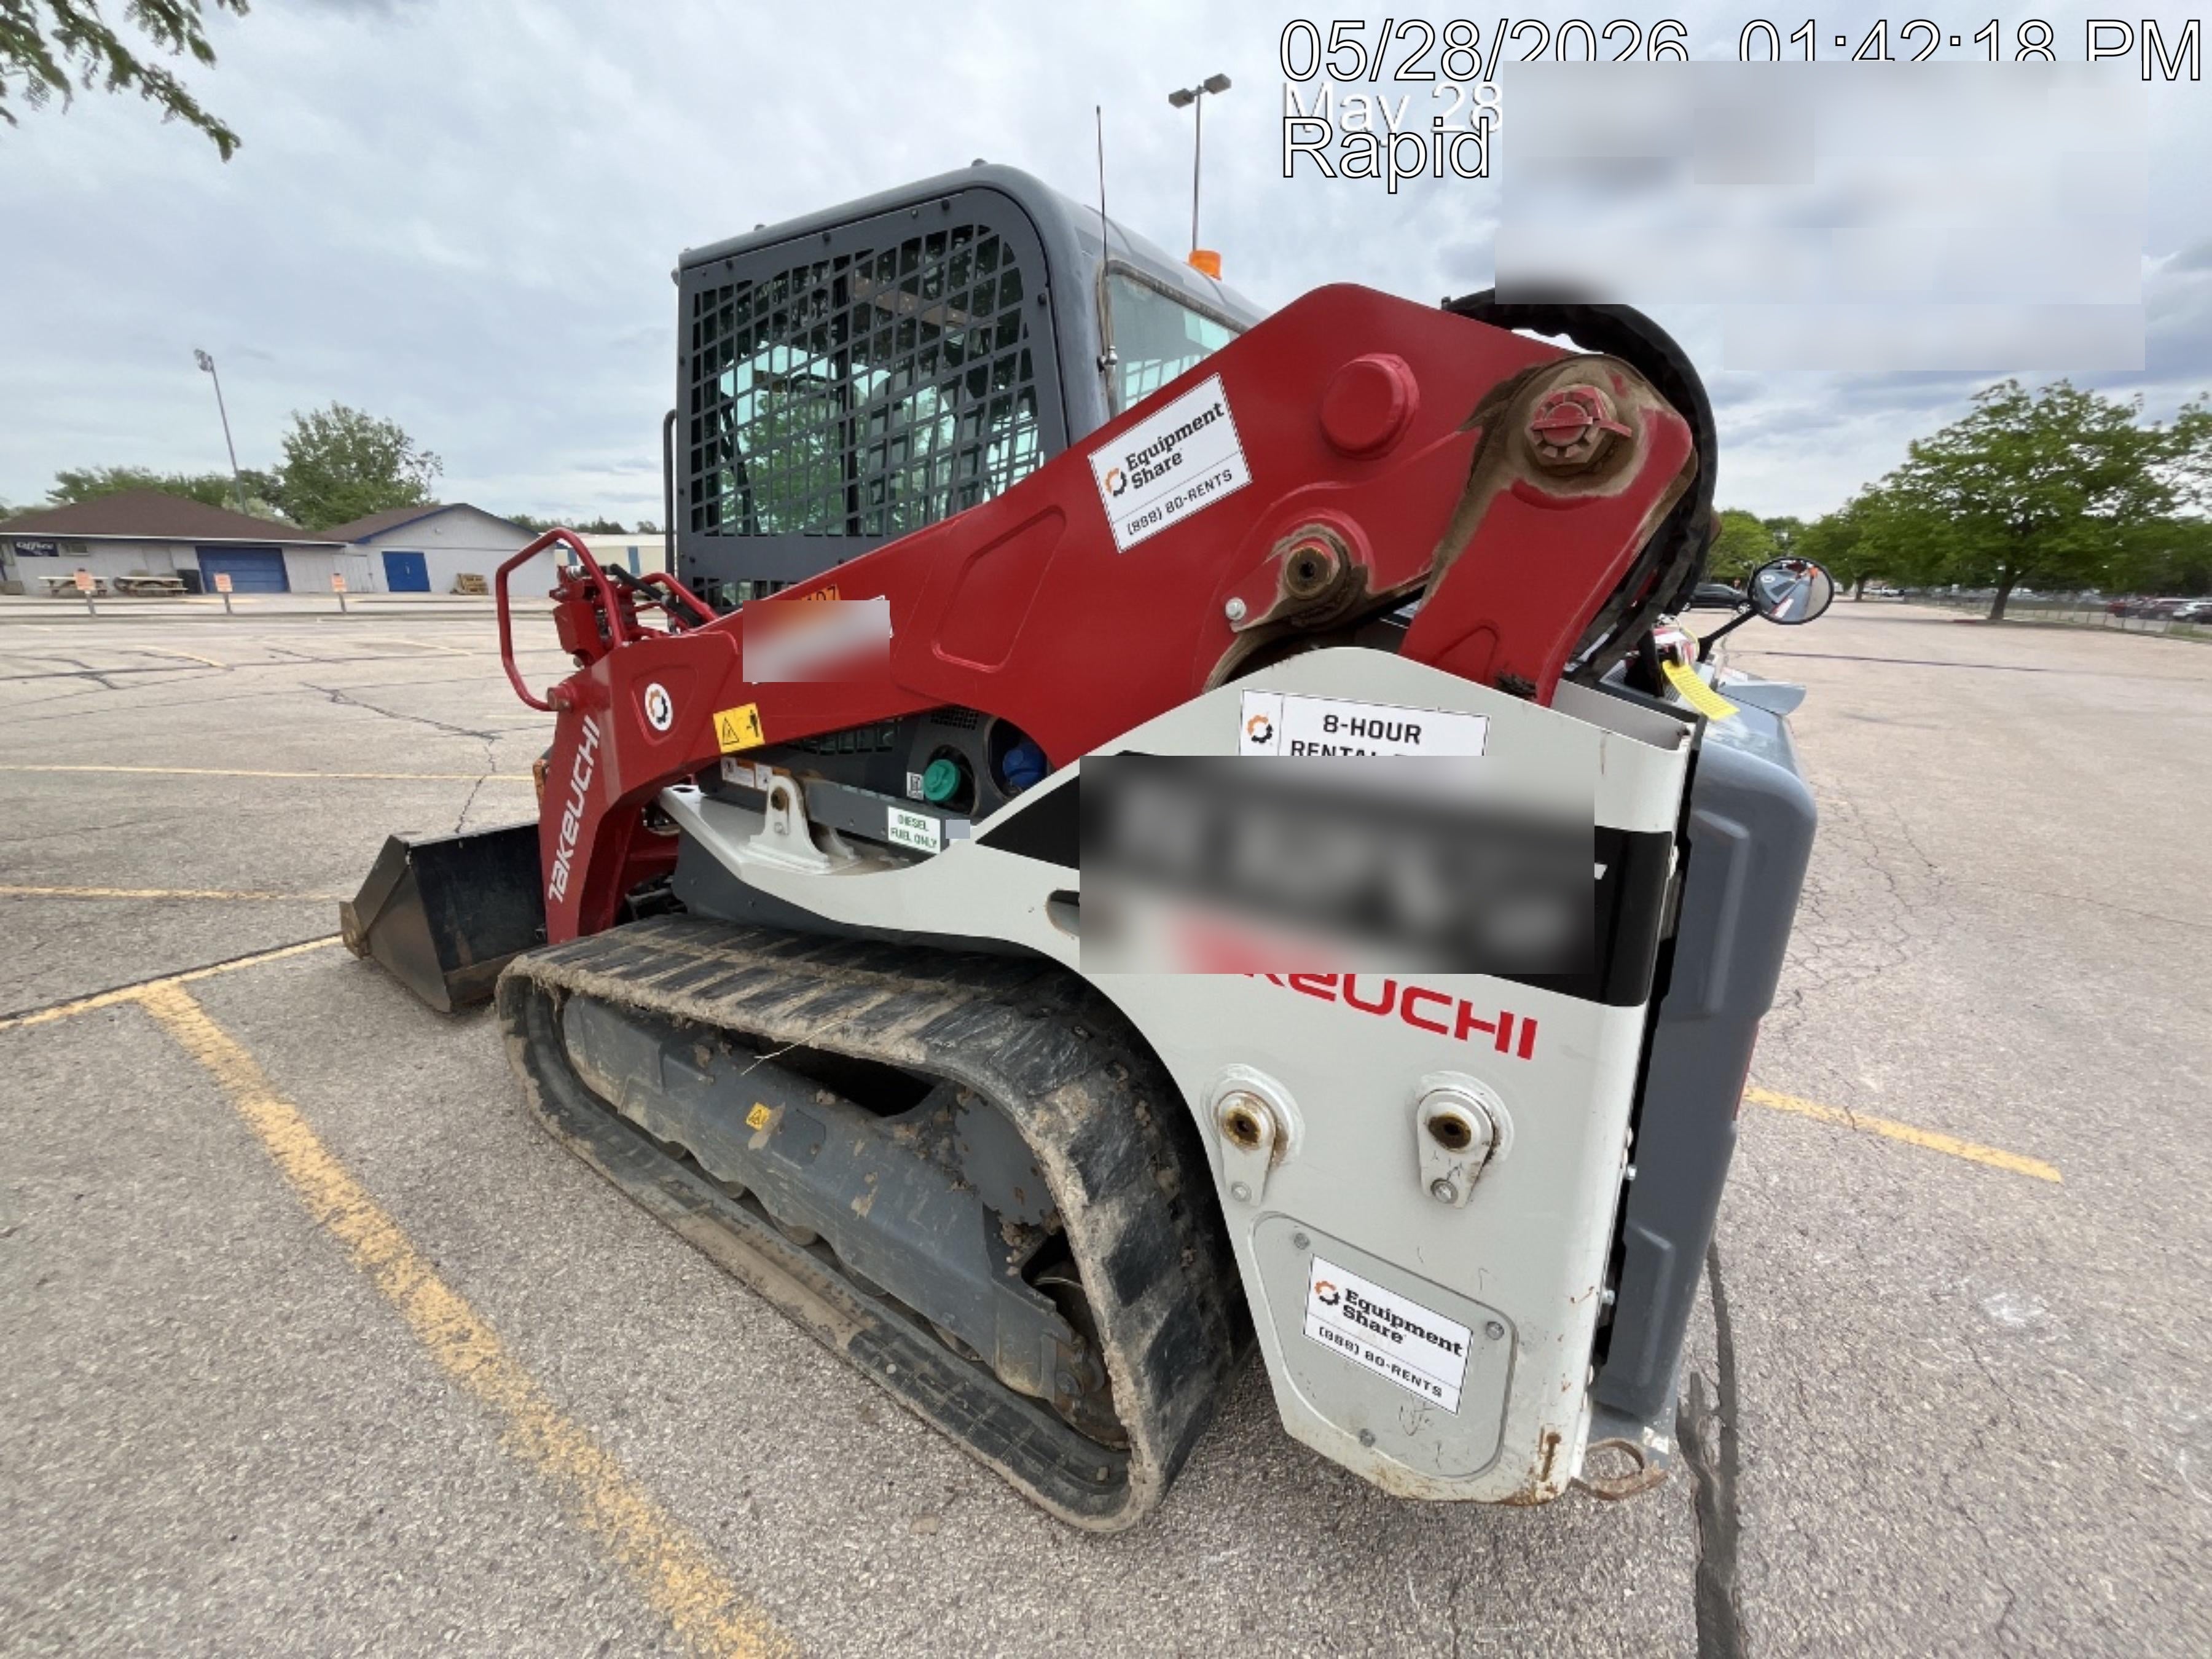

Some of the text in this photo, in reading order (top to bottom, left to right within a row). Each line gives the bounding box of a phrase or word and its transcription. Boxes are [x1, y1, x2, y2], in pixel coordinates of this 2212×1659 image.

[1125, 401, 1225, 471] Equipment
[1131, 452, 1183, 489] Share
[1128, 507, 1162, 535] (888)
[1323, 714, 1422, 745] 8-HOUR
[890, 827, 937, 849] FUEL ONLY
[898, 814, 928, 831] DIESEL
[1343, 1304, 1404, 1344] Share
[1346, 1288, 1462, 1357] Equipment
[1319, 1327, 1359, 1355] (888)
